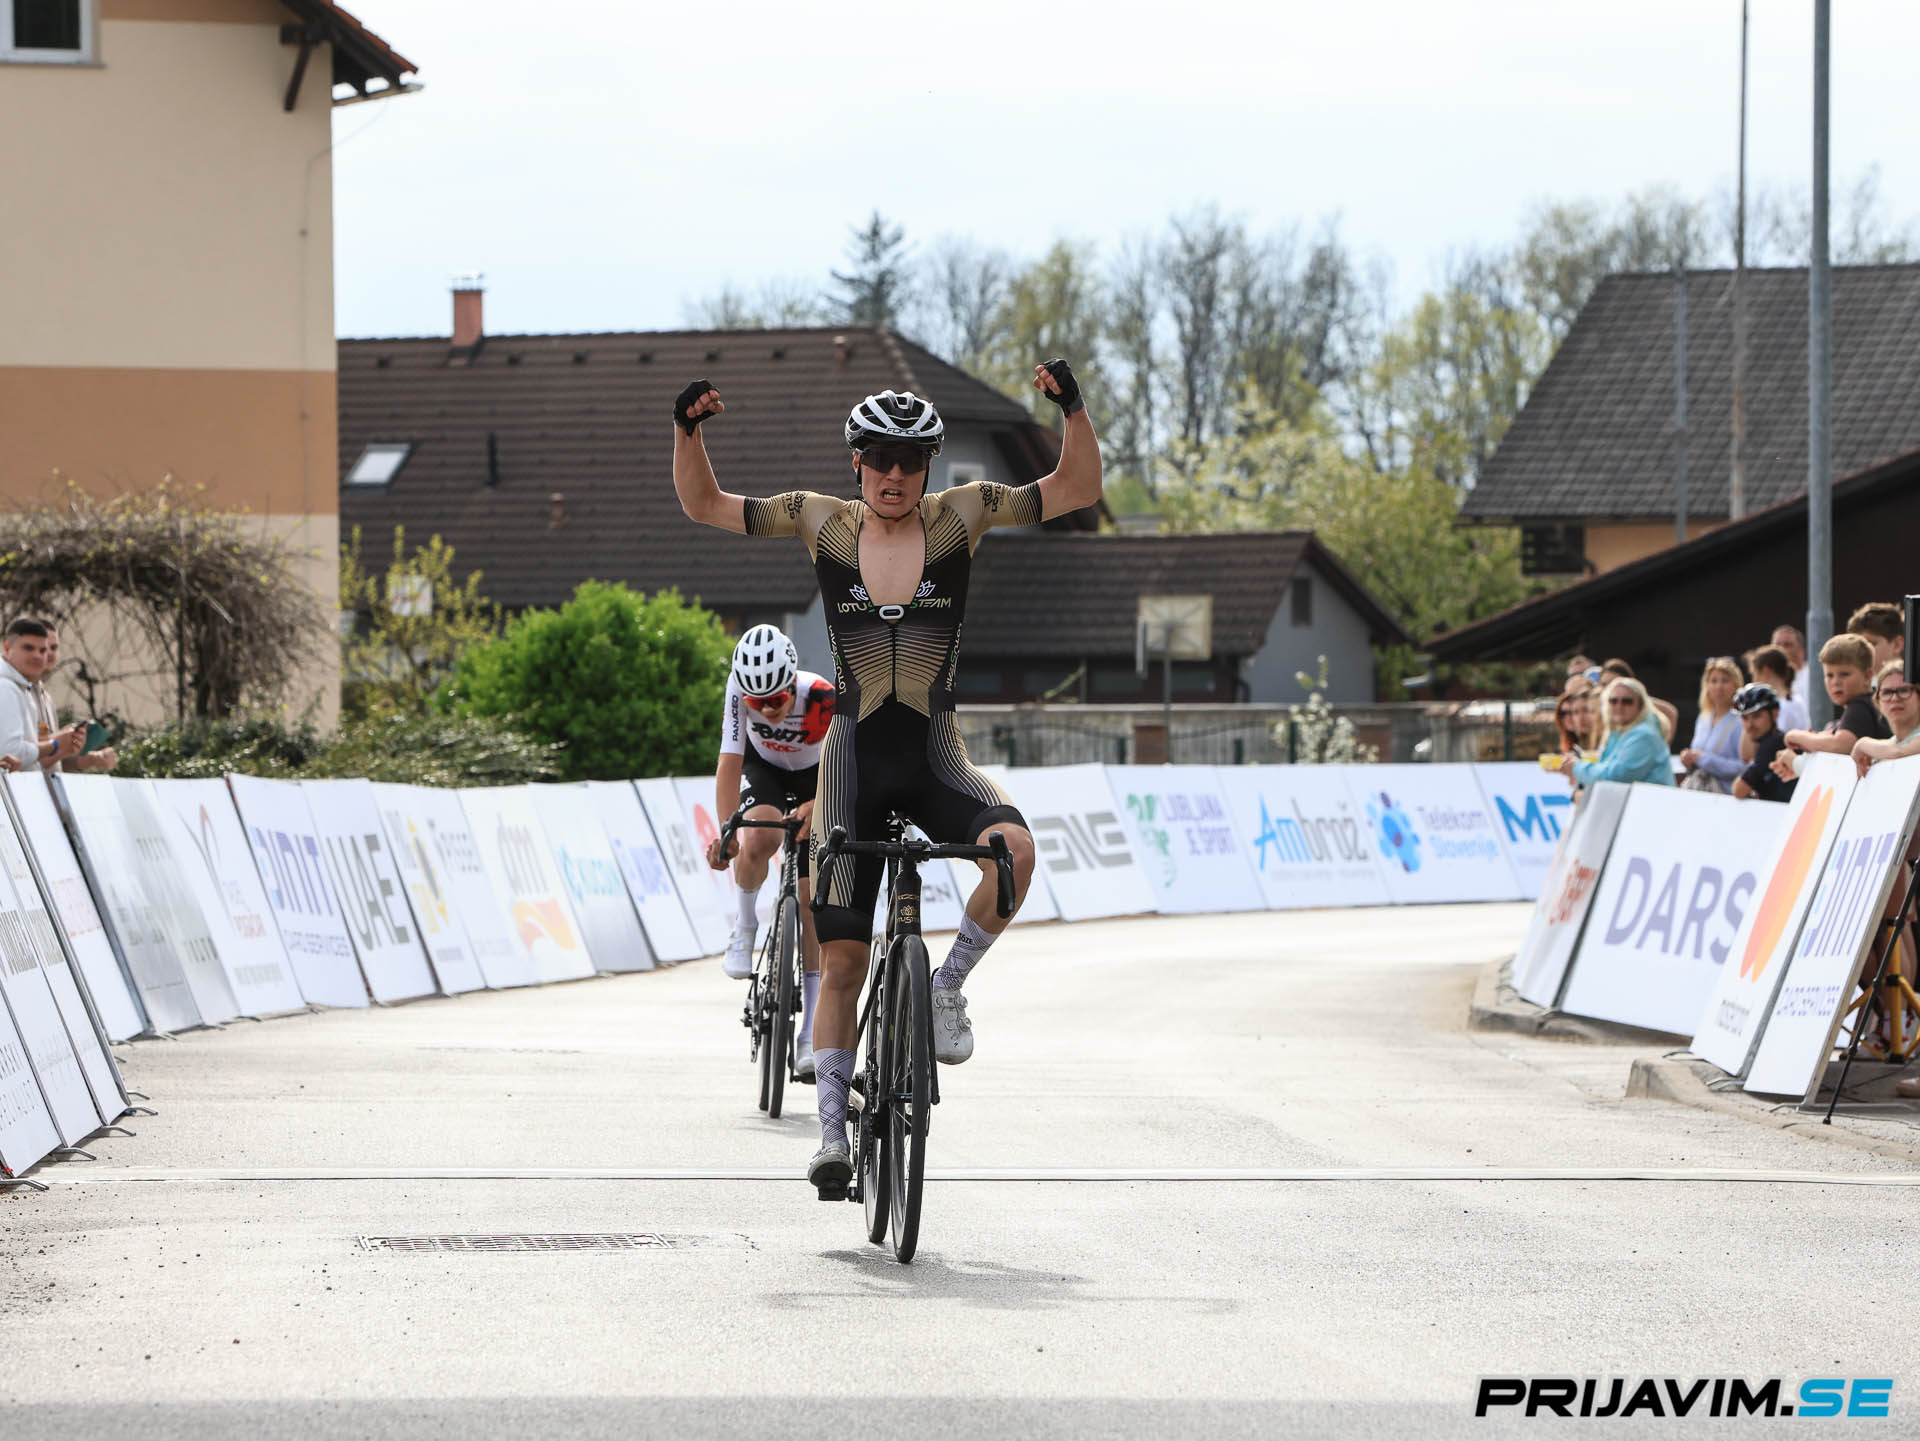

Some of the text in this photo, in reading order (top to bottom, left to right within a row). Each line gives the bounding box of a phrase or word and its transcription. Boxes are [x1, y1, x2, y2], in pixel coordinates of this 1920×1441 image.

[732, 694, 740, 742] PANACEO
[326, 834, 410, 951] UAE
[1603, 856, 1758, 965] DARS
